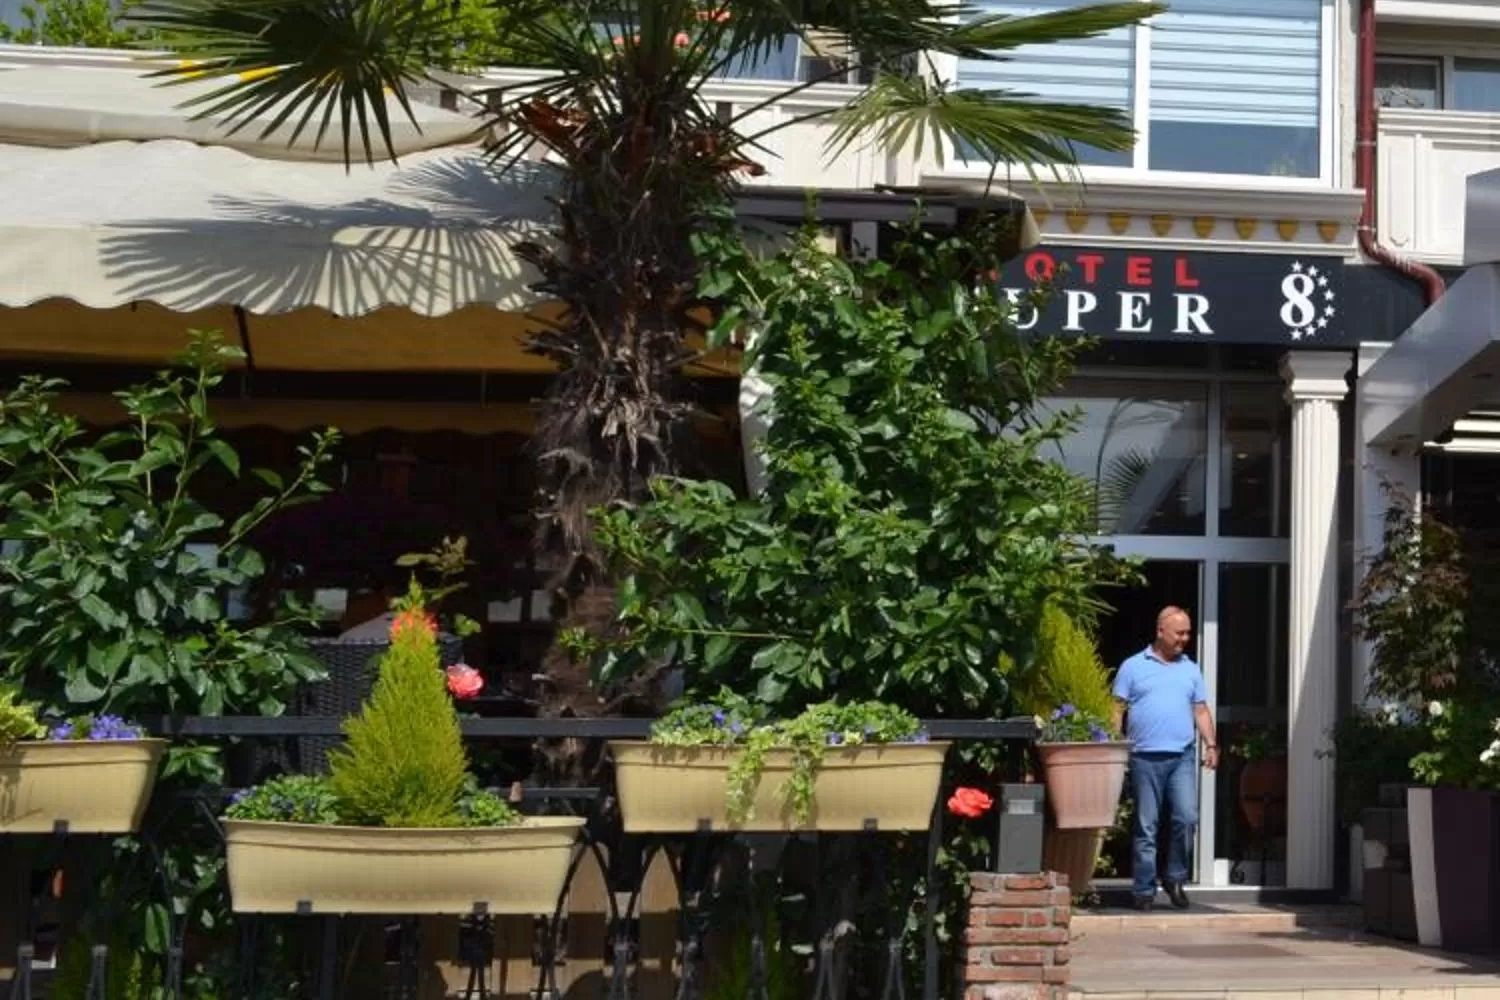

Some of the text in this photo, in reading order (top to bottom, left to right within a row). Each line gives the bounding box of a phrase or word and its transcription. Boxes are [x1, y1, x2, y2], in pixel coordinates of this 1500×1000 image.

[986, 253, 1199, 286] OTEL
[974, 272, 1316, 335] UPER 8
